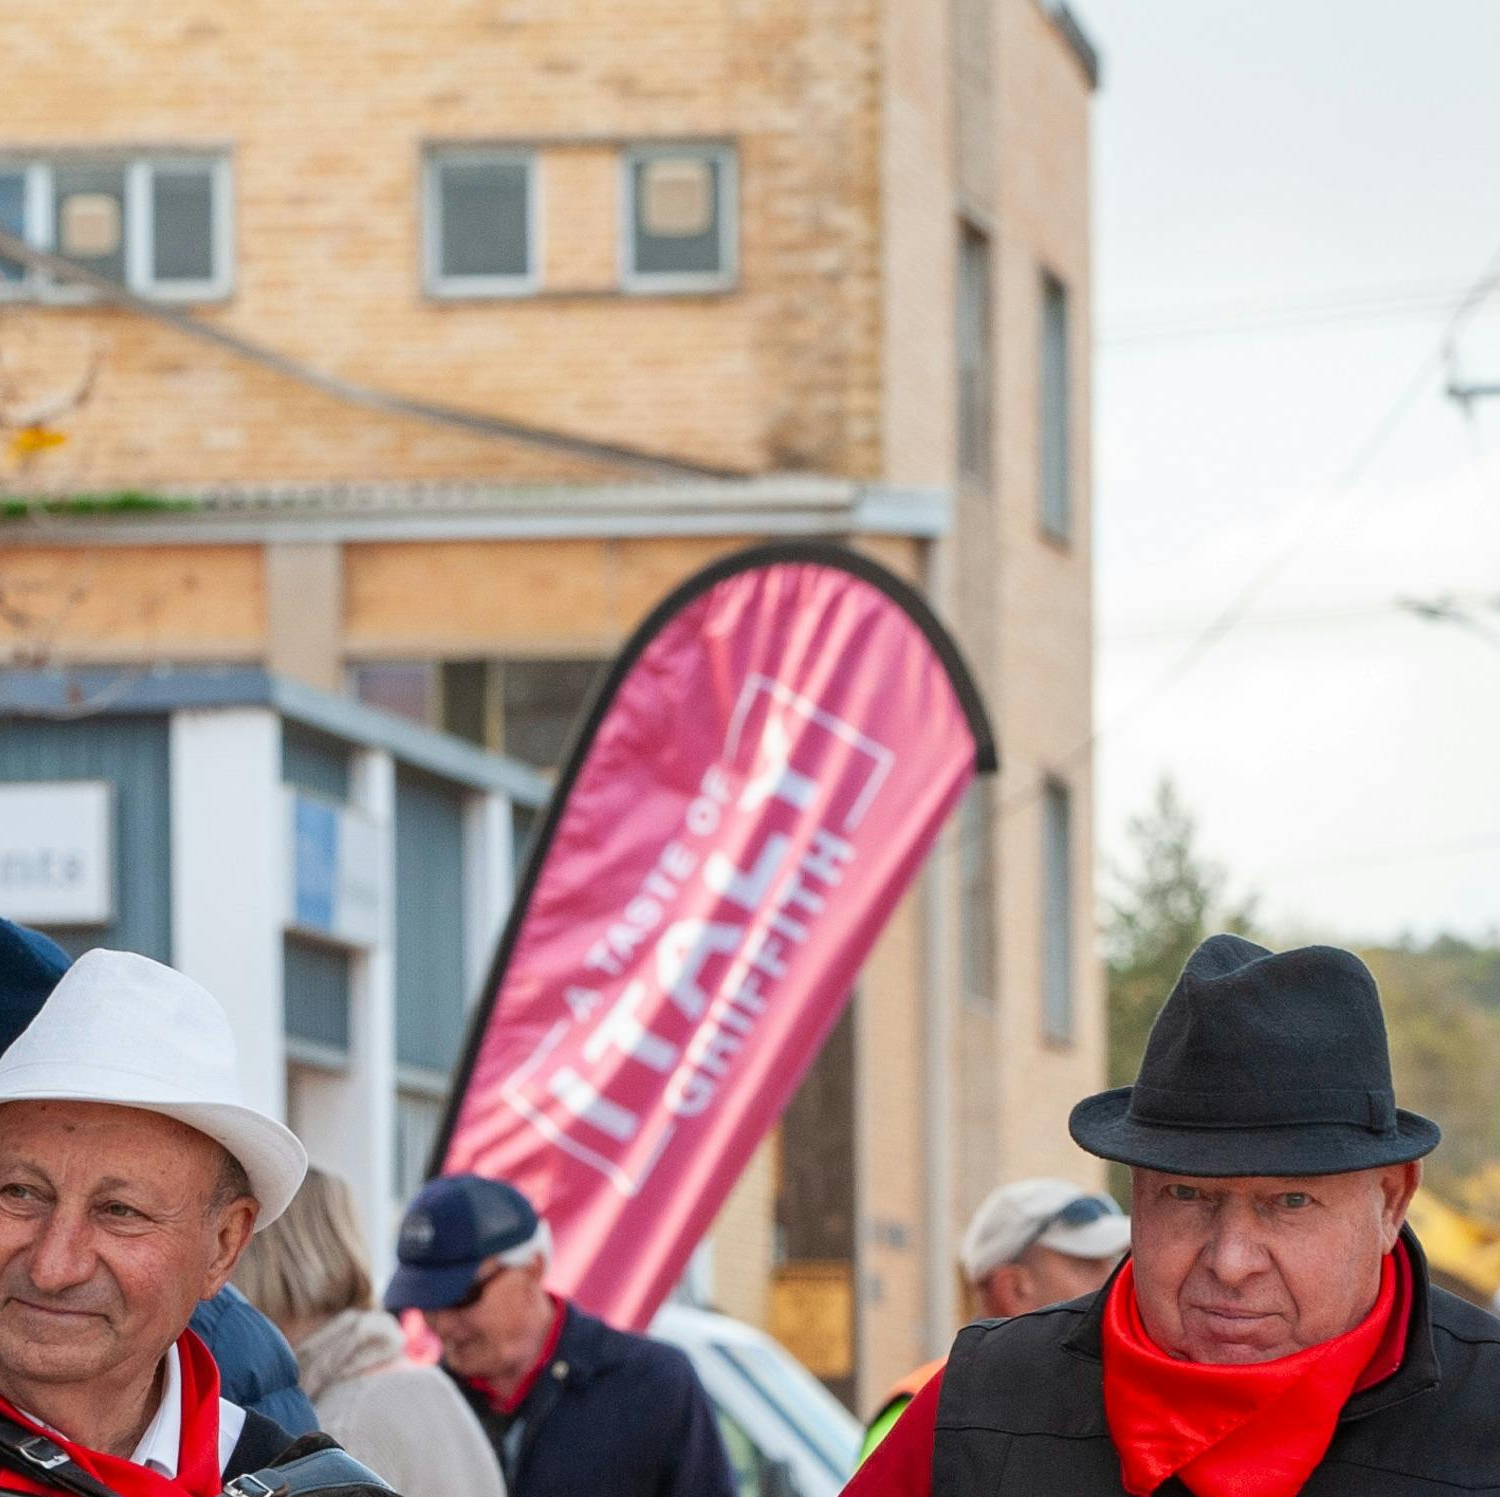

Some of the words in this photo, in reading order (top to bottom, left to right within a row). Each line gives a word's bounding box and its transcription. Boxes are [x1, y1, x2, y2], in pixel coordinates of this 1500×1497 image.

[549, 714, 818, 1142] ITALY
[565, 988, 602, 1021] A
[587, 845, 700, 977] TASTE
[687, 765, 732, 836] OF
[667, 825, 857, 1119] GRIFFITH
